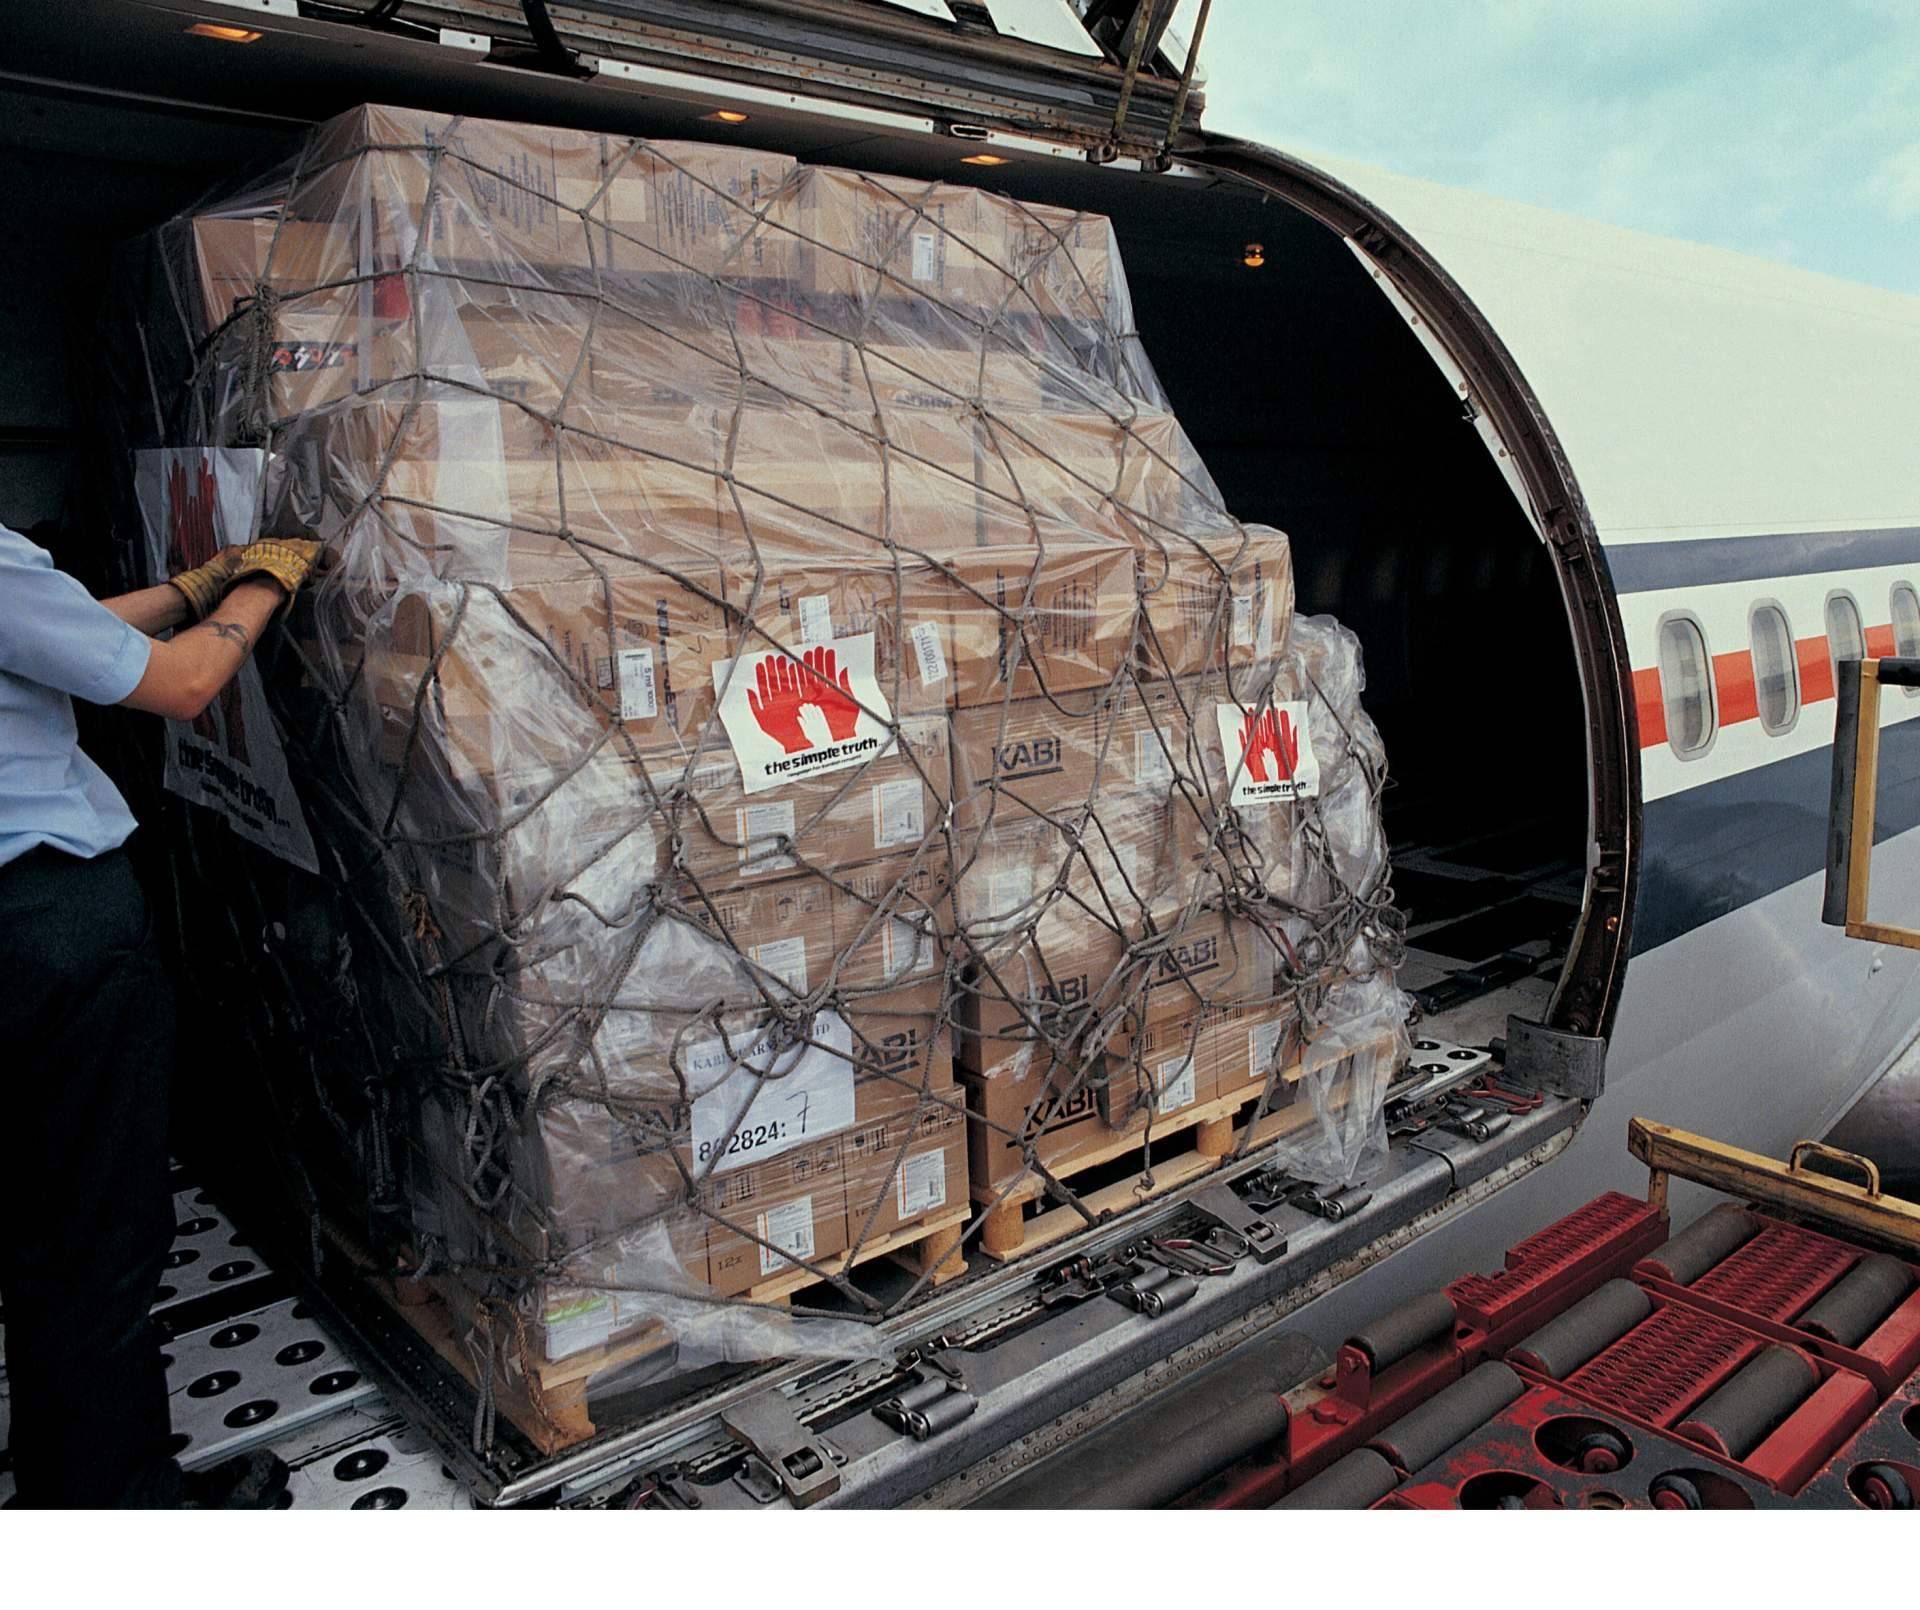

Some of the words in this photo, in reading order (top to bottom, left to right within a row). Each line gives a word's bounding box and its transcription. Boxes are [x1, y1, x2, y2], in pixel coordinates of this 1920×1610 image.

[764, 760, 790, 775] the
[791, 746, 840, 768] simple
[992, 736, 1061, 771] KABI
[1243, 785, 1257, 796] the
[1024, 1086, 1094, 1132] KABI
